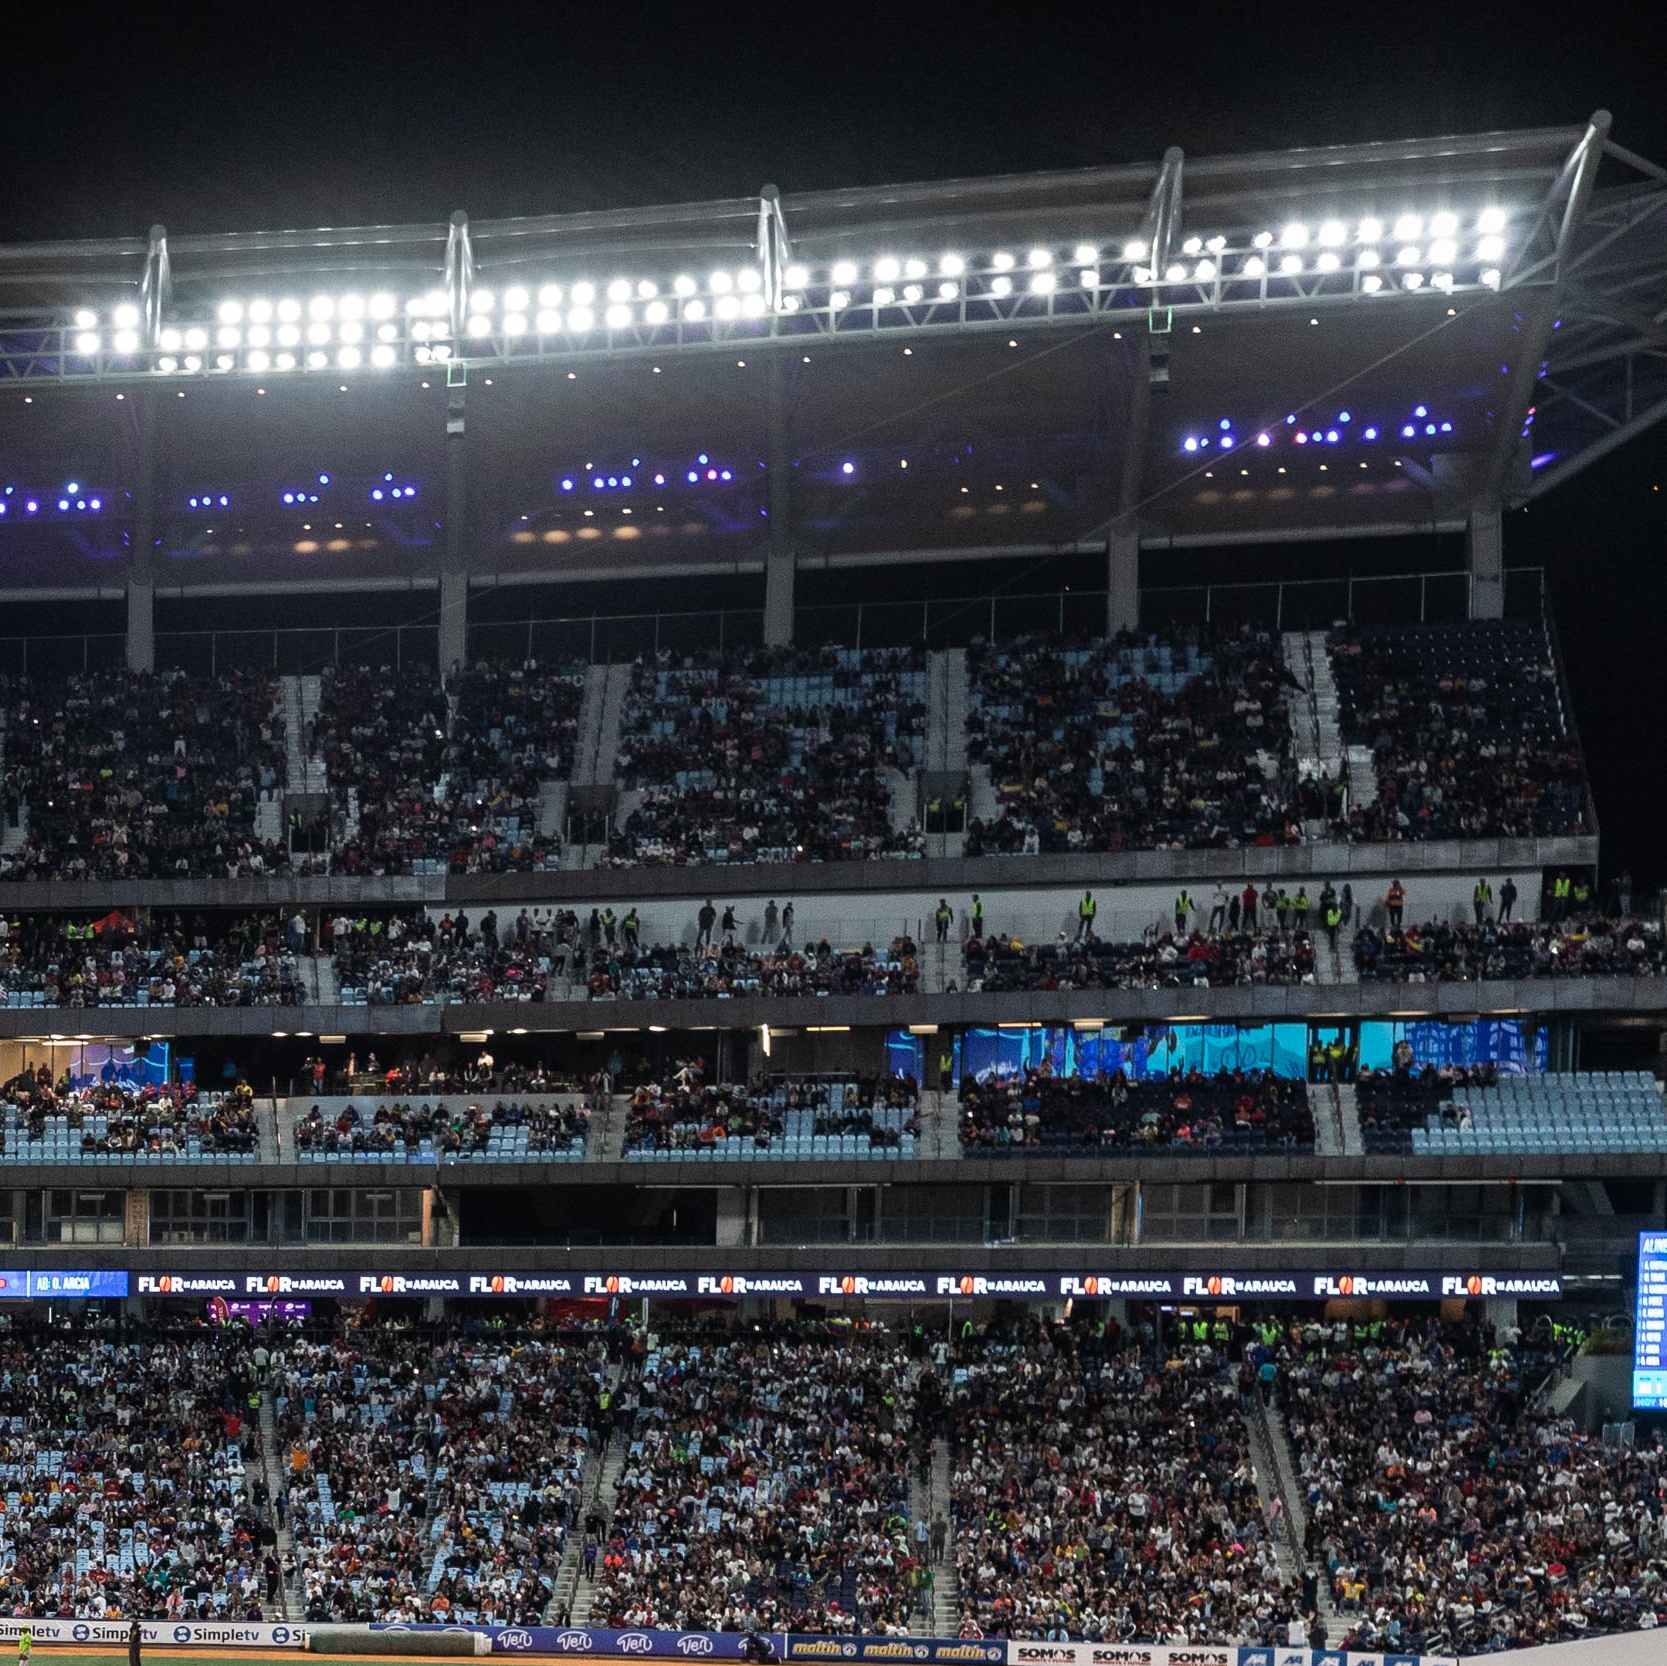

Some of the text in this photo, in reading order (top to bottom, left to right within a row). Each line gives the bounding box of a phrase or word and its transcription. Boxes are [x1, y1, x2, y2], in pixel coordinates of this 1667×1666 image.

[62, 1276, 90, 1290] ARCIA
[138, 1276, 235, 1292] FLOR ARAUCA
[246, 1276, 344, 1292] FLOR ARAUCA
[359, 1276, 459, 1292] FLOR ARAUCA
[469, 1276, 570, 1292] FLOR ARAUCA
[583, 1276, 686, 1293] FLOR ARAUCA
[697, 1276, 802, 1293] FLOR ARAUCA
[818, 1276, 925, 1293] FLOR ARAUCA
[936, 1276, 1045, 1294] FLOR ARAUCA
[1060, 1276, 1171, 1294] FLOR ARAUCA
[1183, 1276, 1296, 1294] FLOR ARAUCA
[1313, 1276, 1429, 1294] FLOR ARAUCA
[1441, 1276, 1559, 1294] FLOR ARAUCA
[92, 1625, 158, 1642] Simptv
[194, 1628, 259, 1644] Simpletv
[1018, 1648, 1076, 1660] SOMOS
[1093, 1650, 1152, 1662] SOMOS
[1168, 1652, 1228, 1664] SOMOS
